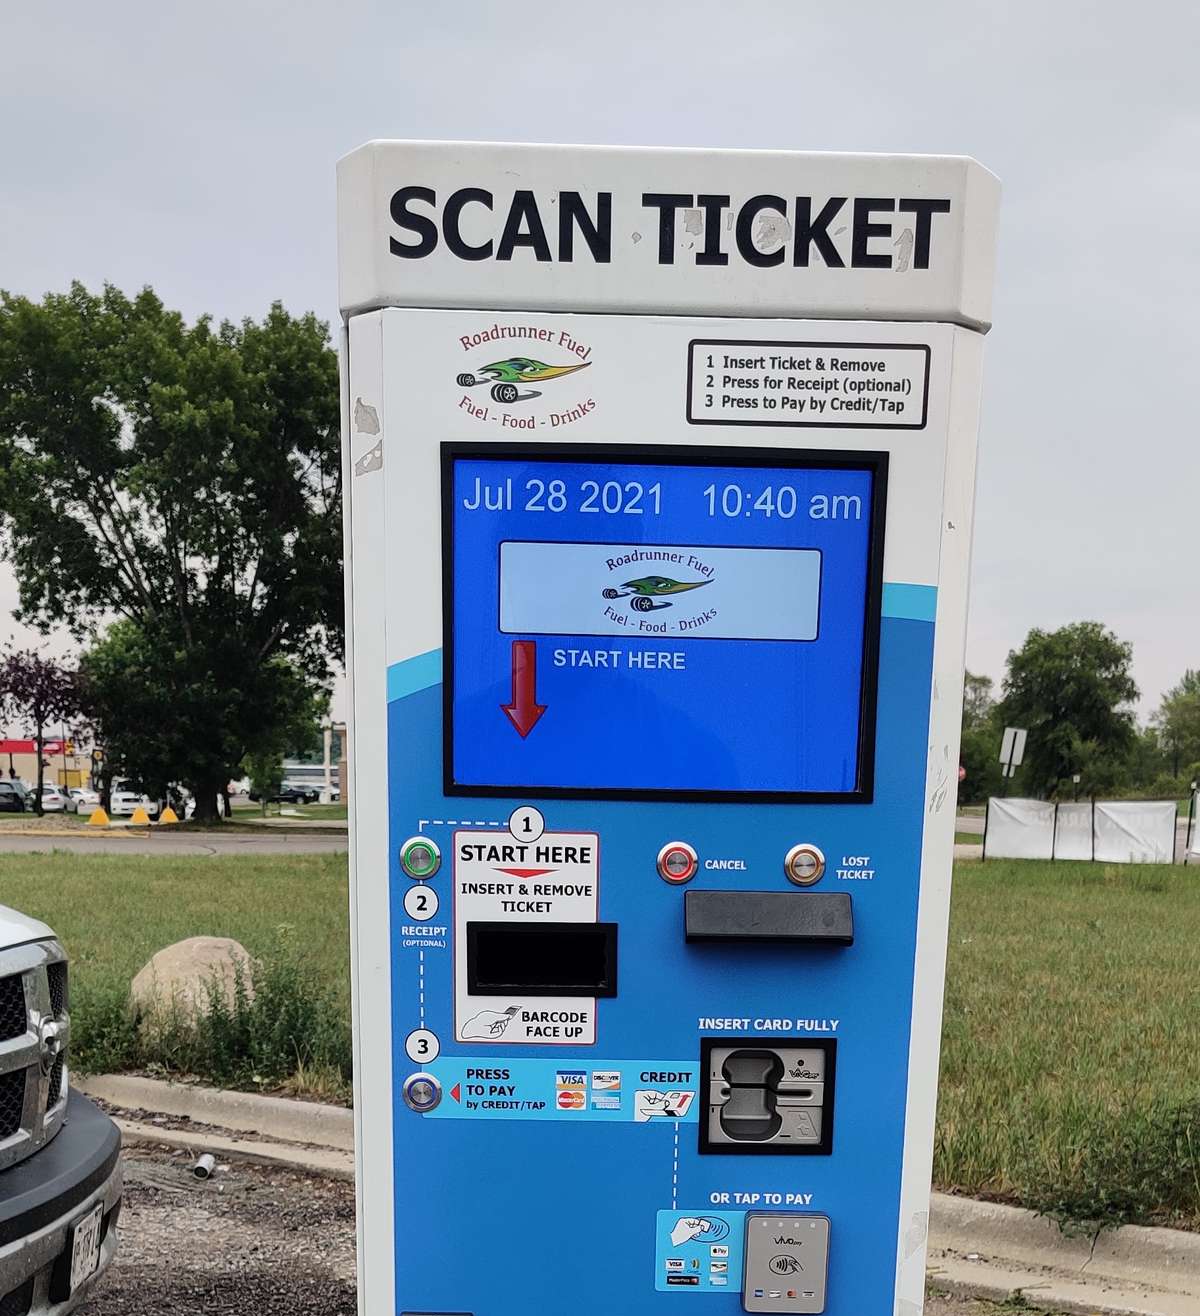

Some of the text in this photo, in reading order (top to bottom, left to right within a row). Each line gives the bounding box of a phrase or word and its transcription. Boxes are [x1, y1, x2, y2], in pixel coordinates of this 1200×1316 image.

[389, 185, 951, 270] SCAN TICKET
[459, 324, 592, 360] Roadrunner Fuel
[707, 355, 886, 372] 1 Insert Ticket & Remove
[706, 375, 911, 395] 2 Press for Receipt (optional)
[705, 395, 905, 414] 3 Press to Pay by Credit/Tap
[458, 395, 488, 421] Fuel
[502, 413, 535, 429] Food
[549, 398, 596, 427] Drinks
[464, 477, 662, 516] Jul 28 2021
[703, 484, 862, 520] 10:40 am
[605, 549, 714, 577] Roadrunner Fuel
[604, 606, 628, 626] Fuel
[639, 620, 667, 633] Food
[679, 608, 717, 631] Drinks
[553, 649, 686, 670] START HERE
[523, 817, 532, 832] 1
[460, 845, 591, 864] START HERE
[705, 859, 747, 870] CANCEL
[842, 857, 870, 867] LOST
[836, 870, 875, 880] TICKET
[461, 883, 592, 897] INSERT & REMOVE
[416, 896, 427, 911] 2
[501, 900, 552, 913] TICKET
[401, 926, 447, 936] RECEIPT
[402, 939, 446, 948] (OPTIONAL)
[522, 1011, 588, 1023] BARCODE
[526, 1026, 583, 1038] FACE UP
[698, 1018, 840, 1032] INSERT CARD FULLY
[417, 1040, 428, 1055] 3
[466, 1069, 510, 1080] PRESS
[561, 1075, 584, 1085] VISA
[640, 1071, 692, 1083] CREDIT
[466, 1085, 515, 1097] TO PAY
[466, 1100, 546, 1111] by CREDIT/TAP
[710, 1192, 813, 1205] OR TAP TO PAY
